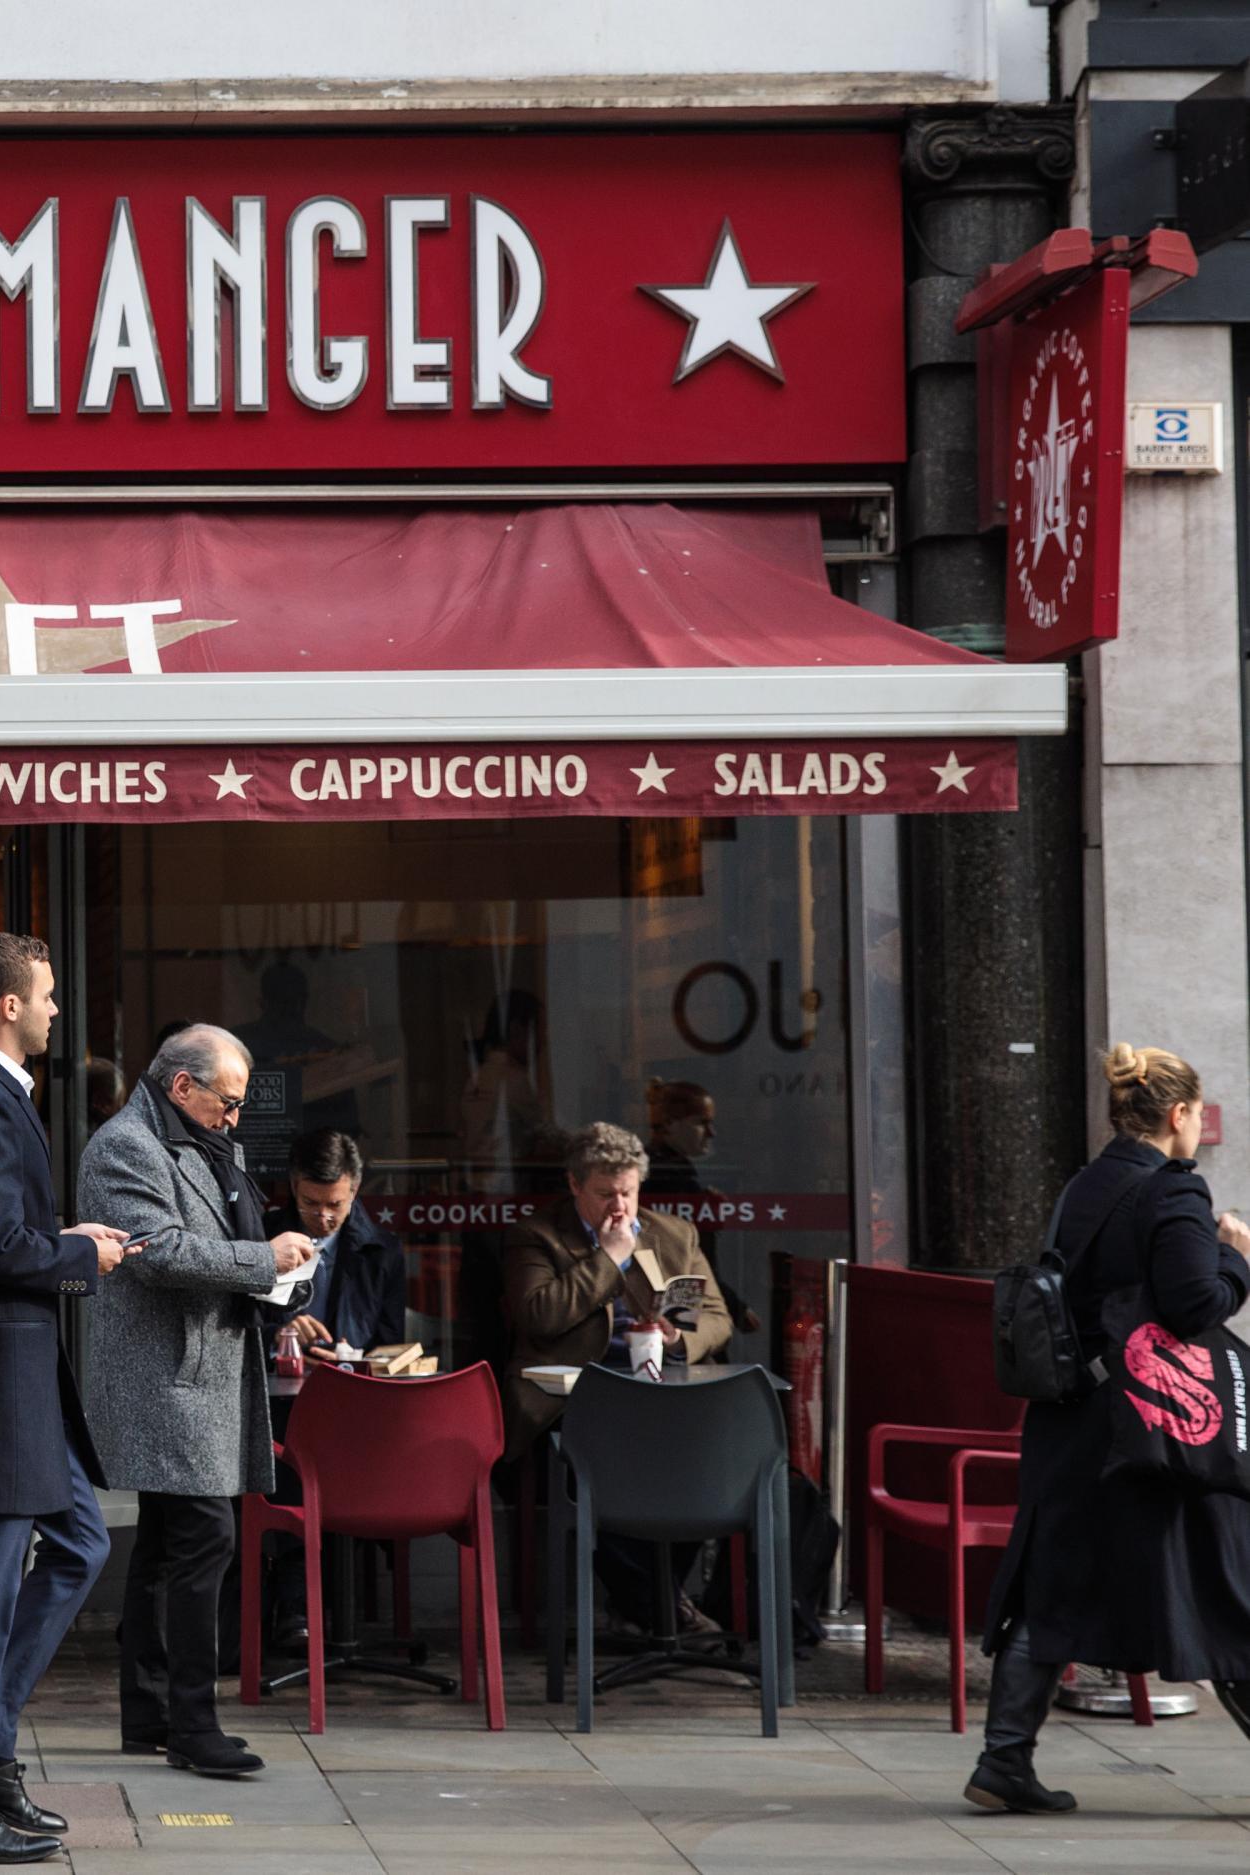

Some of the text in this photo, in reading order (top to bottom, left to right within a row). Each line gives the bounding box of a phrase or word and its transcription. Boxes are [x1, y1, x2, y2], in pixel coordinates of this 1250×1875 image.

[1015, 328, 1094, 480] ORGANIC COFFEE
[1015, 505, 1087, 629] NATURAL FOOD
[288, 753, 588, 801] CAPPUCCINO
[713, 751, 887, 797] SALADS
[1234, 1380, 1247, 1417] CRAFT
